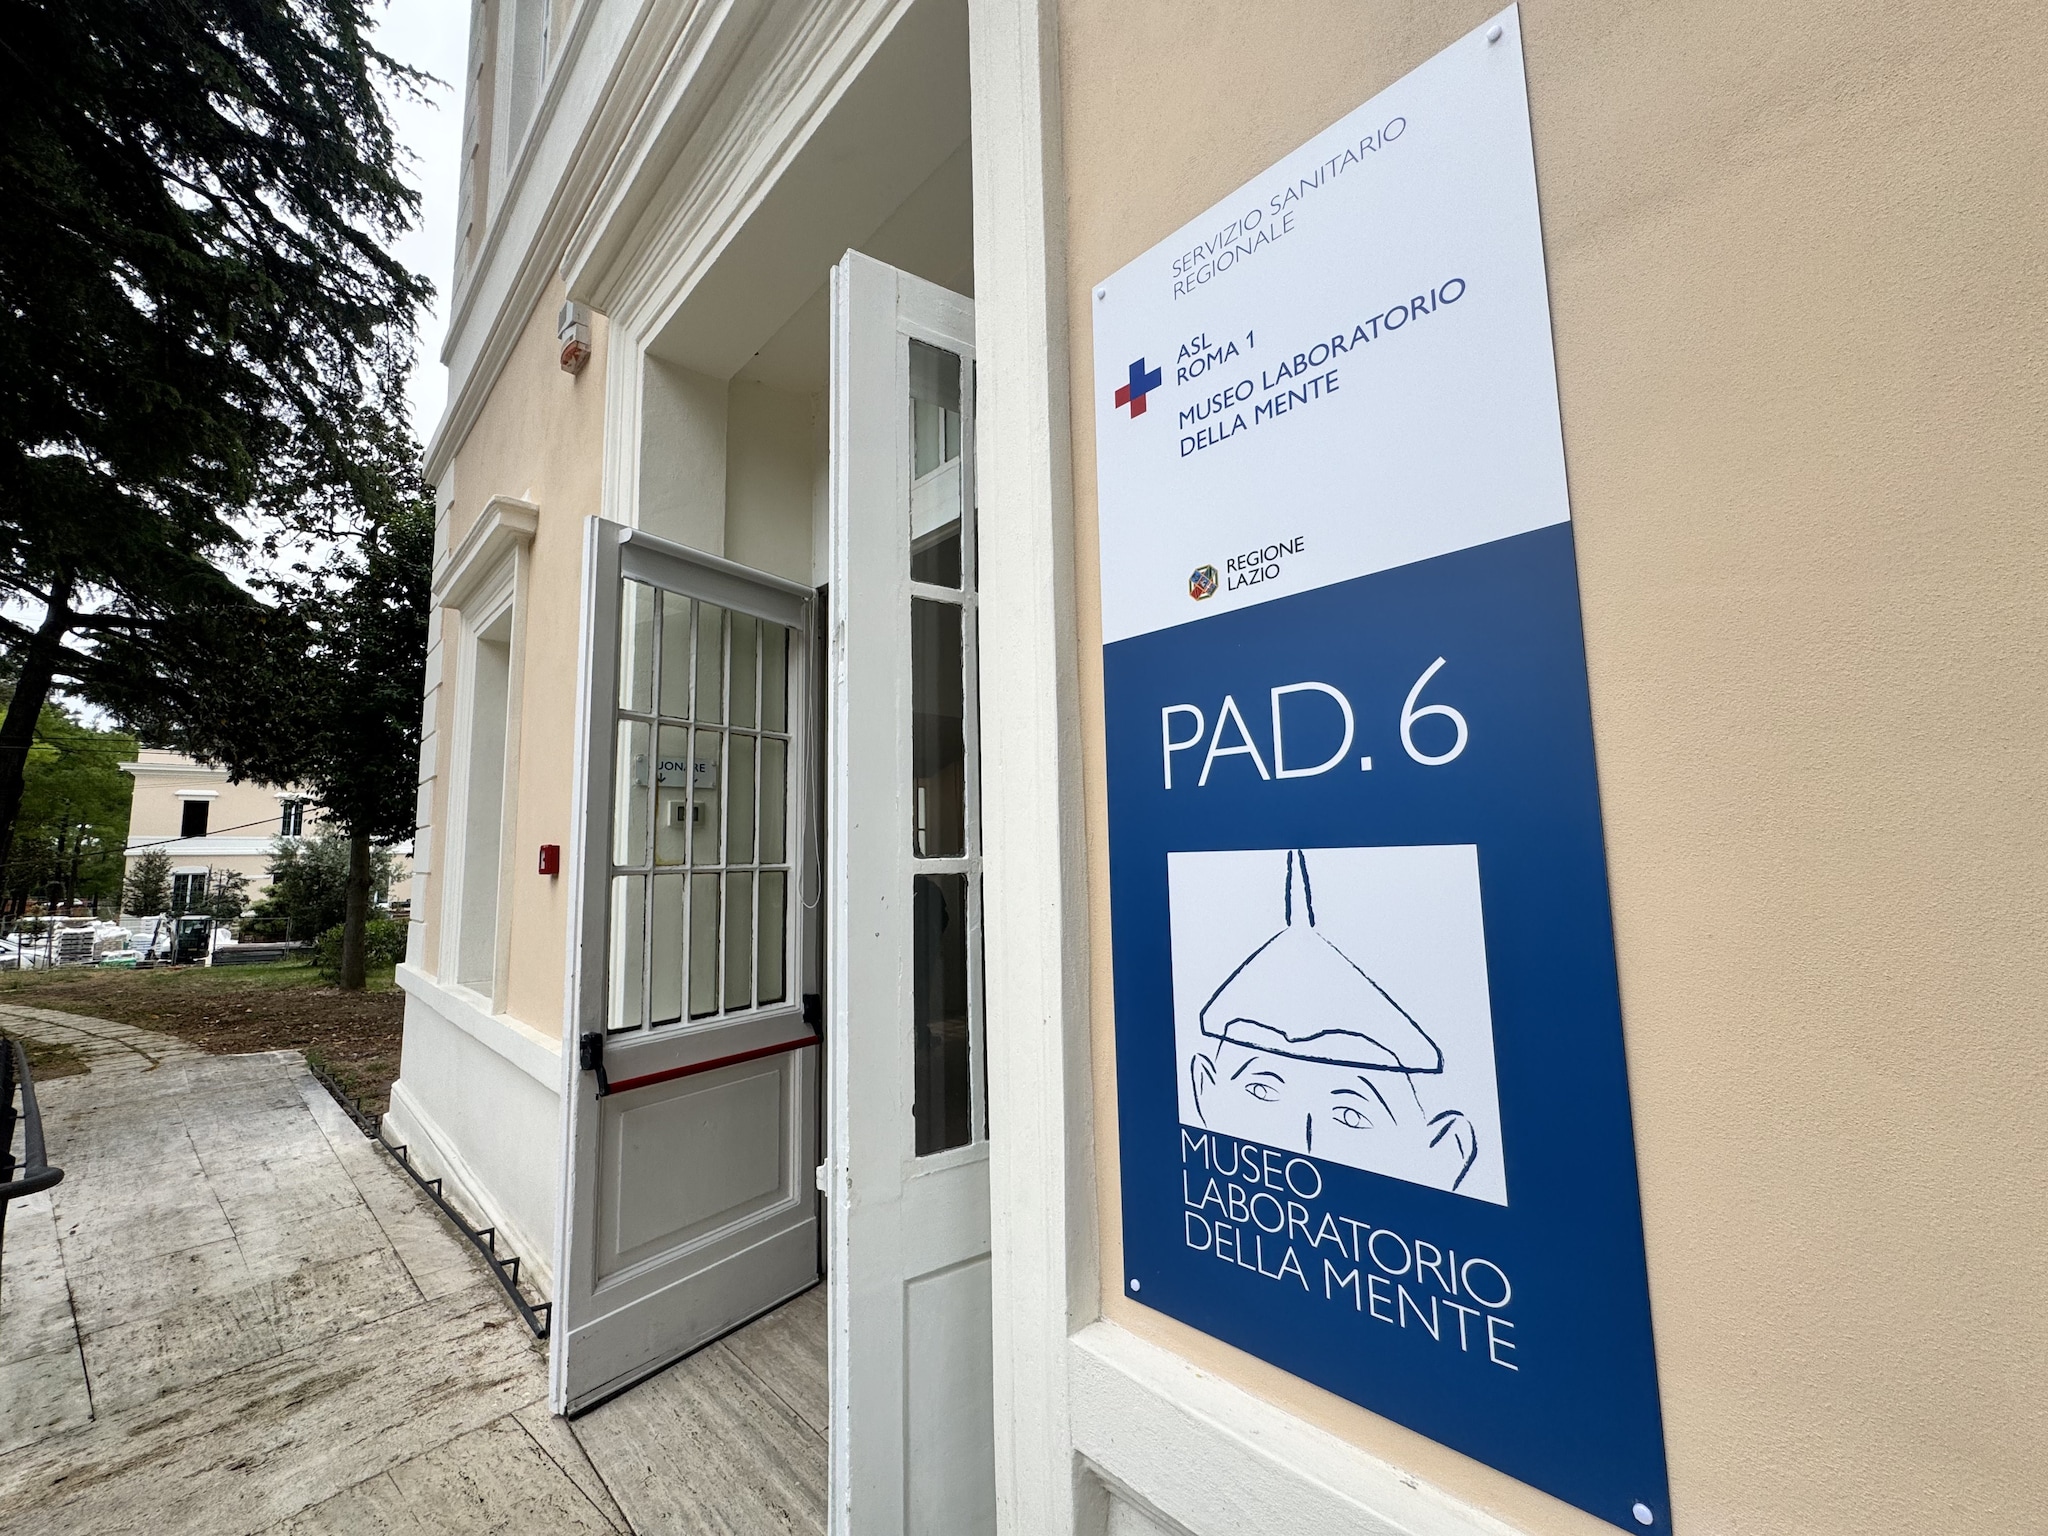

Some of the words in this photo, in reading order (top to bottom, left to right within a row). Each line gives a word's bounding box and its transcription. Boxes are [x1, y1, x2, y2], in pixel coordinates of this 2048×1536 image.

[1172, 209, 1262, 279] SERVIZIO
[1270, 117, 1407, 217] SANITARIO
[1173, 210, 1295, 301] REGIONALE
[1176, 341, 1240, 386] ROMA
[1246, 330, 1255, 349] 1
[1177, 332, 1212, 364] ASL
[1179, 379, 1254, 430] MUSEO
[1262, 277, 1466, 391] LABORATORIO
[1180, 414, 1247, 458] DELLA
[1255, 369, 1340, 425] MENTE
[1226, 536, 1305, 574] REGIONE
[1227, 563, 1280, 591] LAZIO
[658, 761, 706, 773] UONRE
[1161, 681, 1372, 790] PAD.
[1399, 656, 1468, 766] 6
[1180, 1128, 1322, 1199] MUSEO
[1183, 1168, 1512, 1309] LABORATORIO
[1185, 1210, 1310, 1292] DELLA
[1323, 1258, 1519, 1371] MENTE
